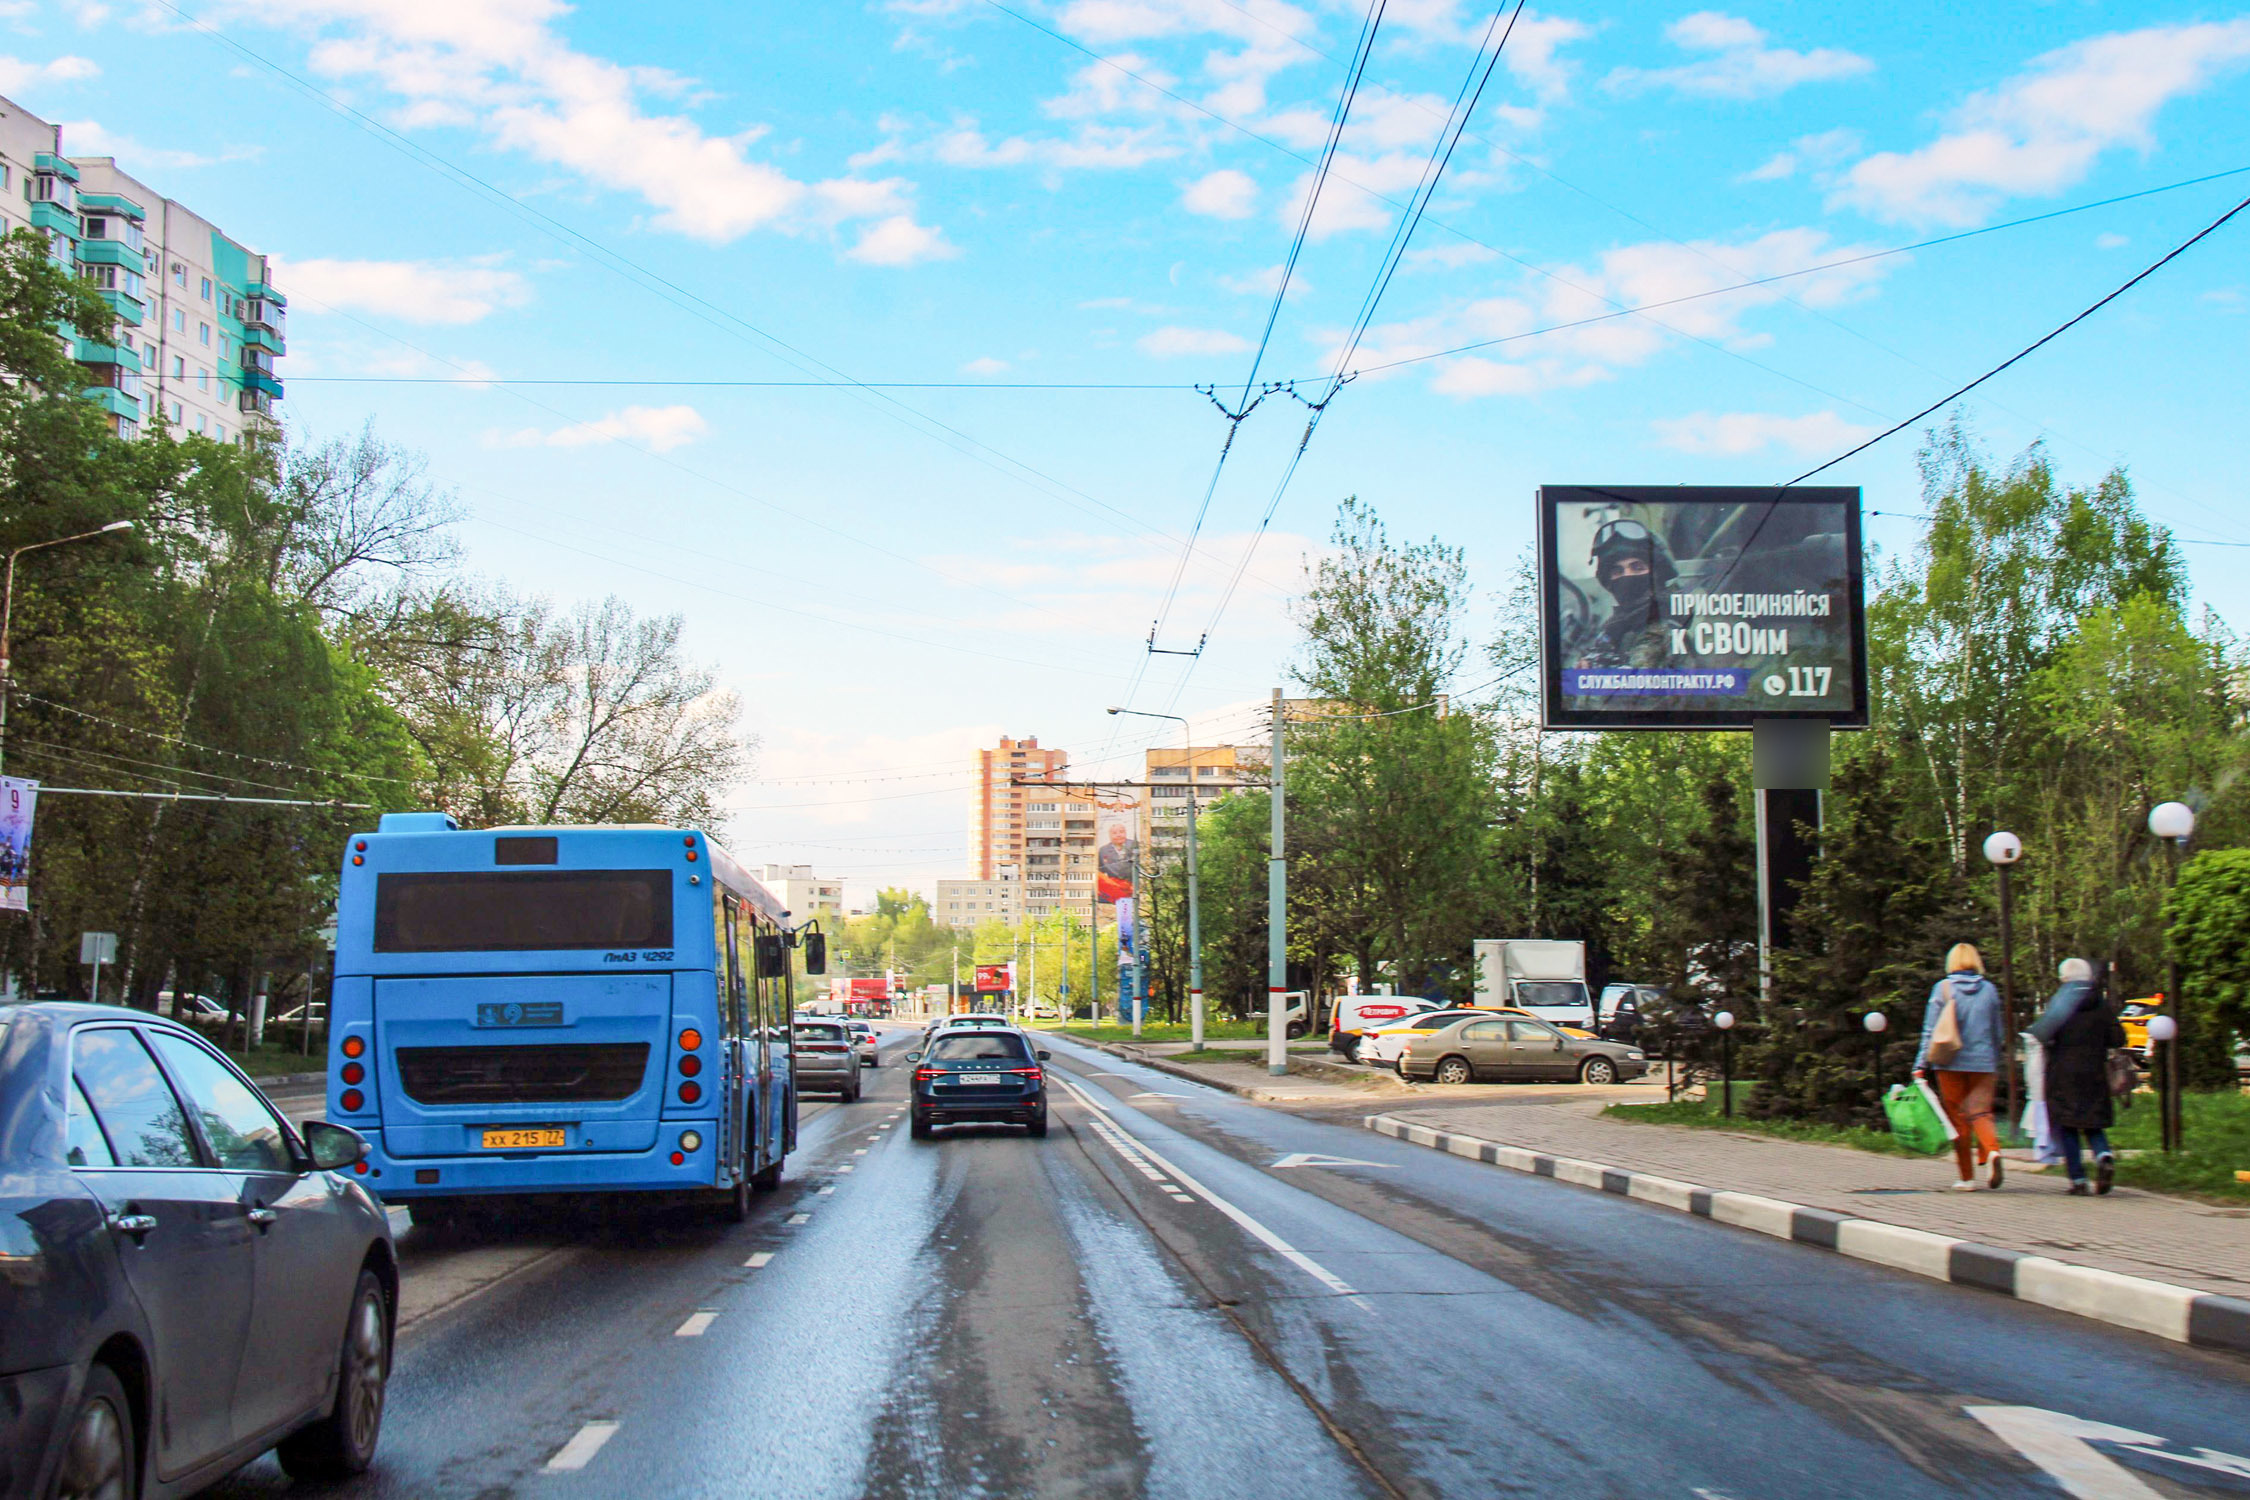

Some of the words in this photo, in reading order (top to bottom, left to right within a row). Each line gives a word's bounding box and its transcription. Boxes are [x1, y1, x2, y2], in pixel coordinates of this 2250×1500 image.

[1670, 589, 1831, 618] ПРИСОЕДИНЯЙСЯ
[1694, 621, 1788, 655] СВОим
[1577, 674, 1735, 690] СЛУЖБАПОКОНТРАКТУ.РФ
[1787, 666, 1833, 697] 117
[642, 951, 675, 962] 4292
[512, 1131, 540, 1146] 215
[545, 1130, 560, 1145] 77
